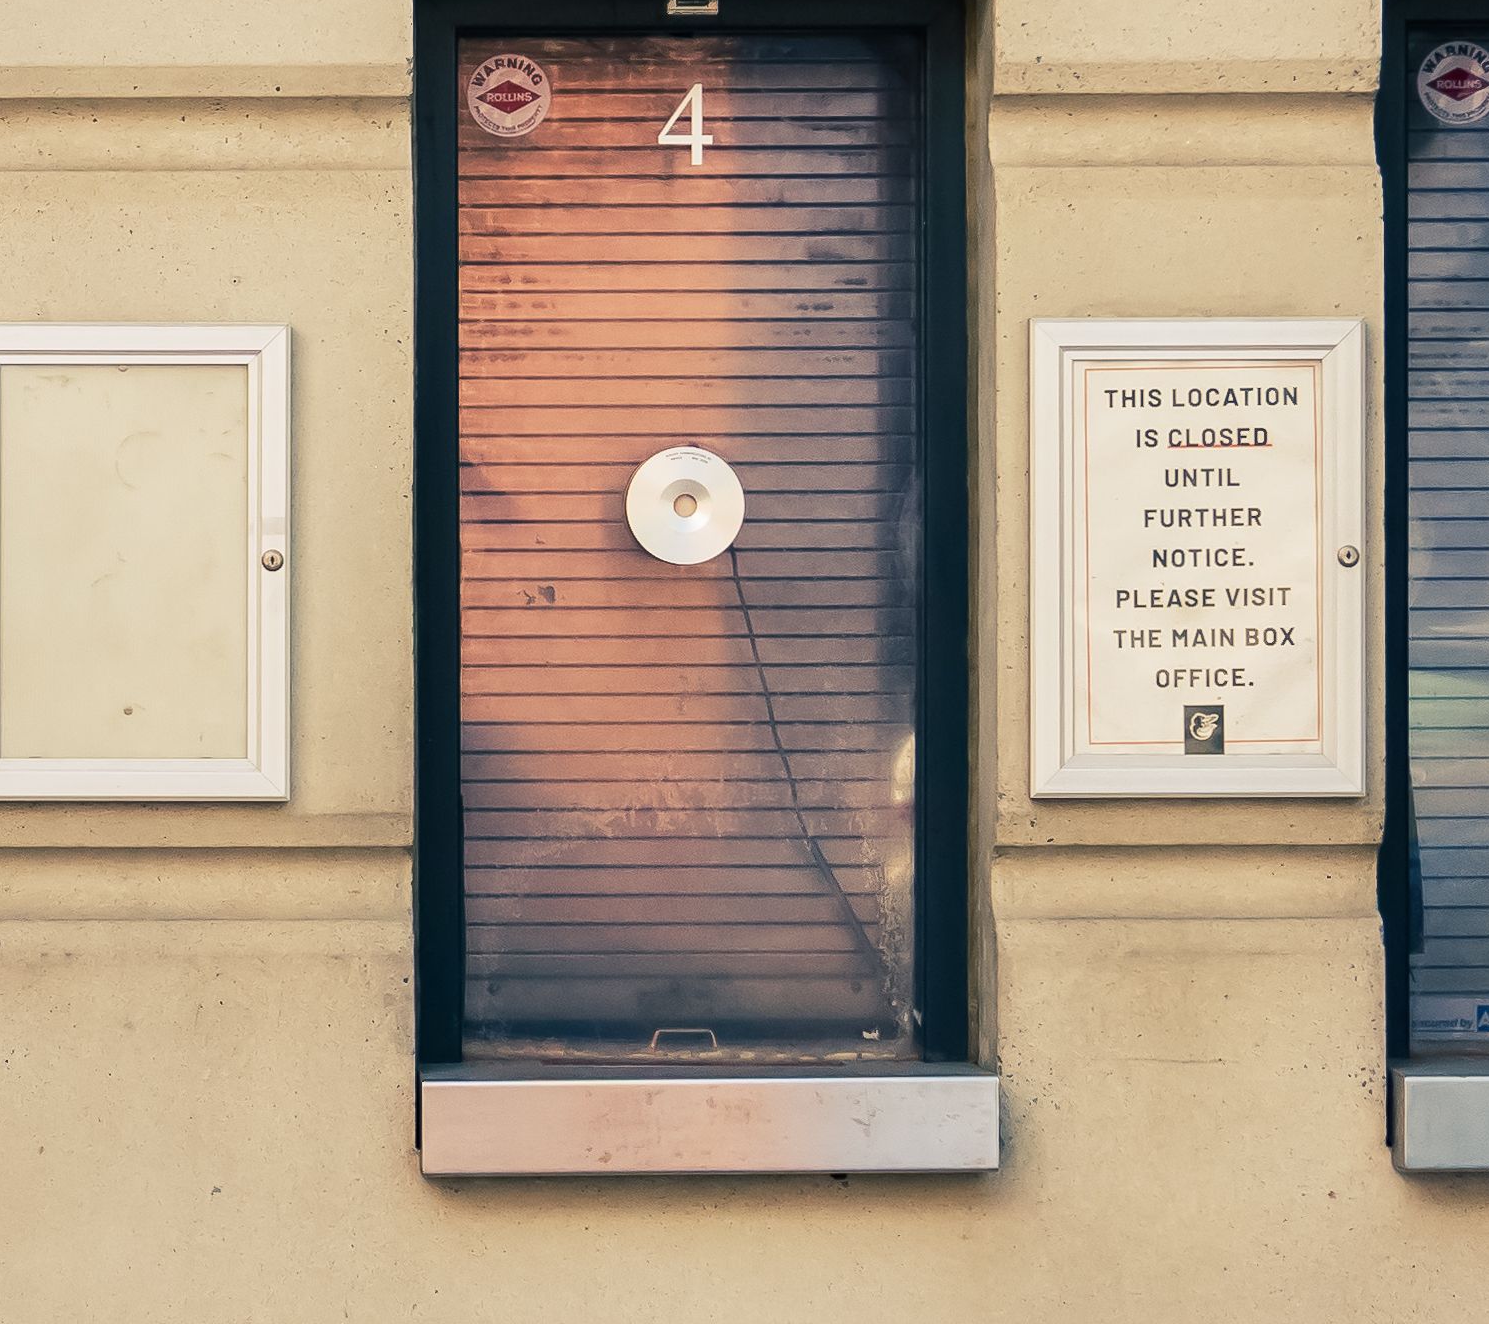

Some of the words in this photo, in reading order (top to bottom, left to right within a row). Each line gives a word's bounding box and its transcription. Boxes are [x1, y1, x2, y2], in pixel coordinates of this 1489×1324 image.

[471, 58, 543, 86] WARNING
[1436, 80, 1482, 89] ROLLINS
[486, 92, 533, 102] ROLLINS
[657, 83, 714, 166] 4
[1103, 386, 1162, 408] THIS
[1172, 386, 1298, 408] LOCATION
[1136, 427, 1159, 449] IS
[1167, 427, 1270, 449] CLOSED
[1164, 467, 1241, 488] UNTIL
[1143, 507, 1262, 528] FURTHER
[1152, 547, 1254, 568] NOTICE.
[1116, 587, 1216, 609] PLEASE
[1225, 587, 1292, 609] VISIT
[1112, 627, 1162, 649] THE
[1171, 627, 1235, 649] MAIN
[1245, 627, 1296, 649] BOX
[1155, 667, 1254, 689] OFFICE.
